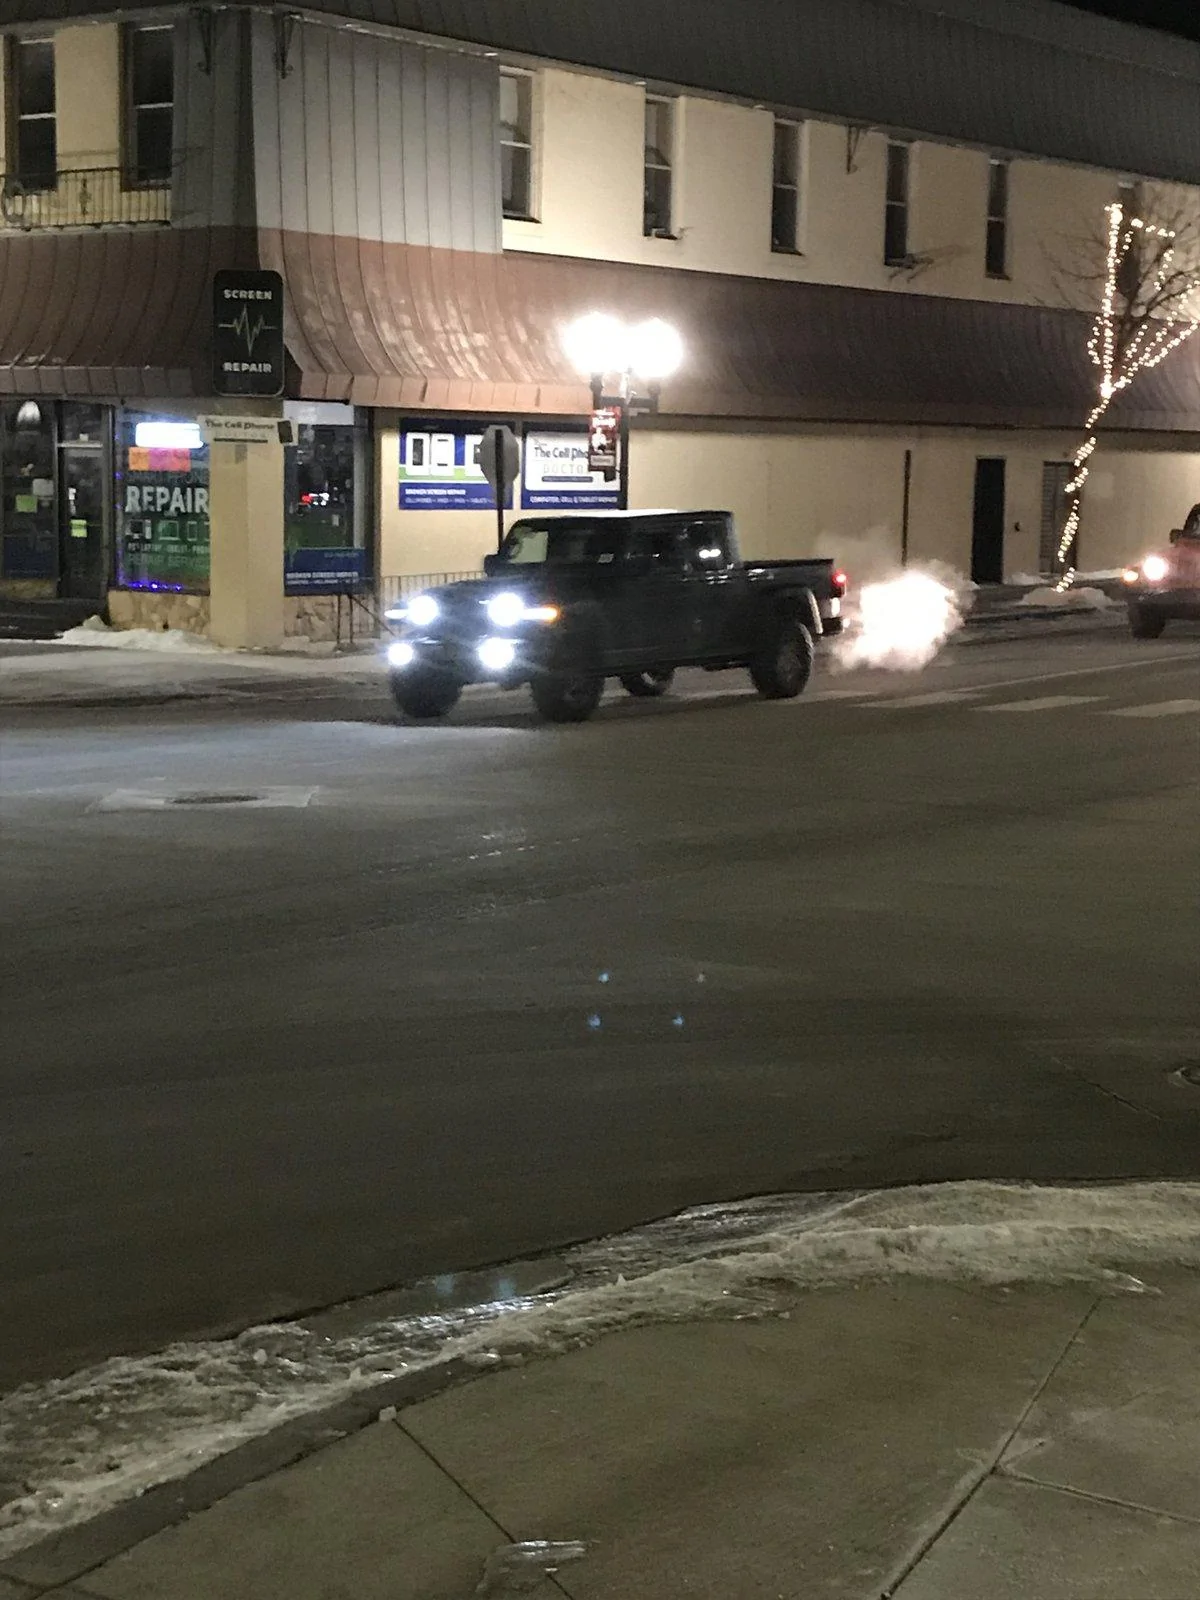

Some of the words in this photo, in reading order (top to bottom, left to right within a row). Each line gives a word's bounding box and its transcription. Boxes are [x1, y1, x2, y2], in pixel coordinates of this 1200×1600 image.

[223, 289, 272, 300] SCREEN
[223, 362, 272, 373] REPAIR
[205, 420, 222, 428] The
[224, 421, 242, 429] Cell
[534, 446, 551, 458] The
[552, 446, 570, 458] Cell
[571, 447, 589, 461] Pho
[543, 463, 589, 474] DOCTO
[125, 485, 208, 513] REPAIR
